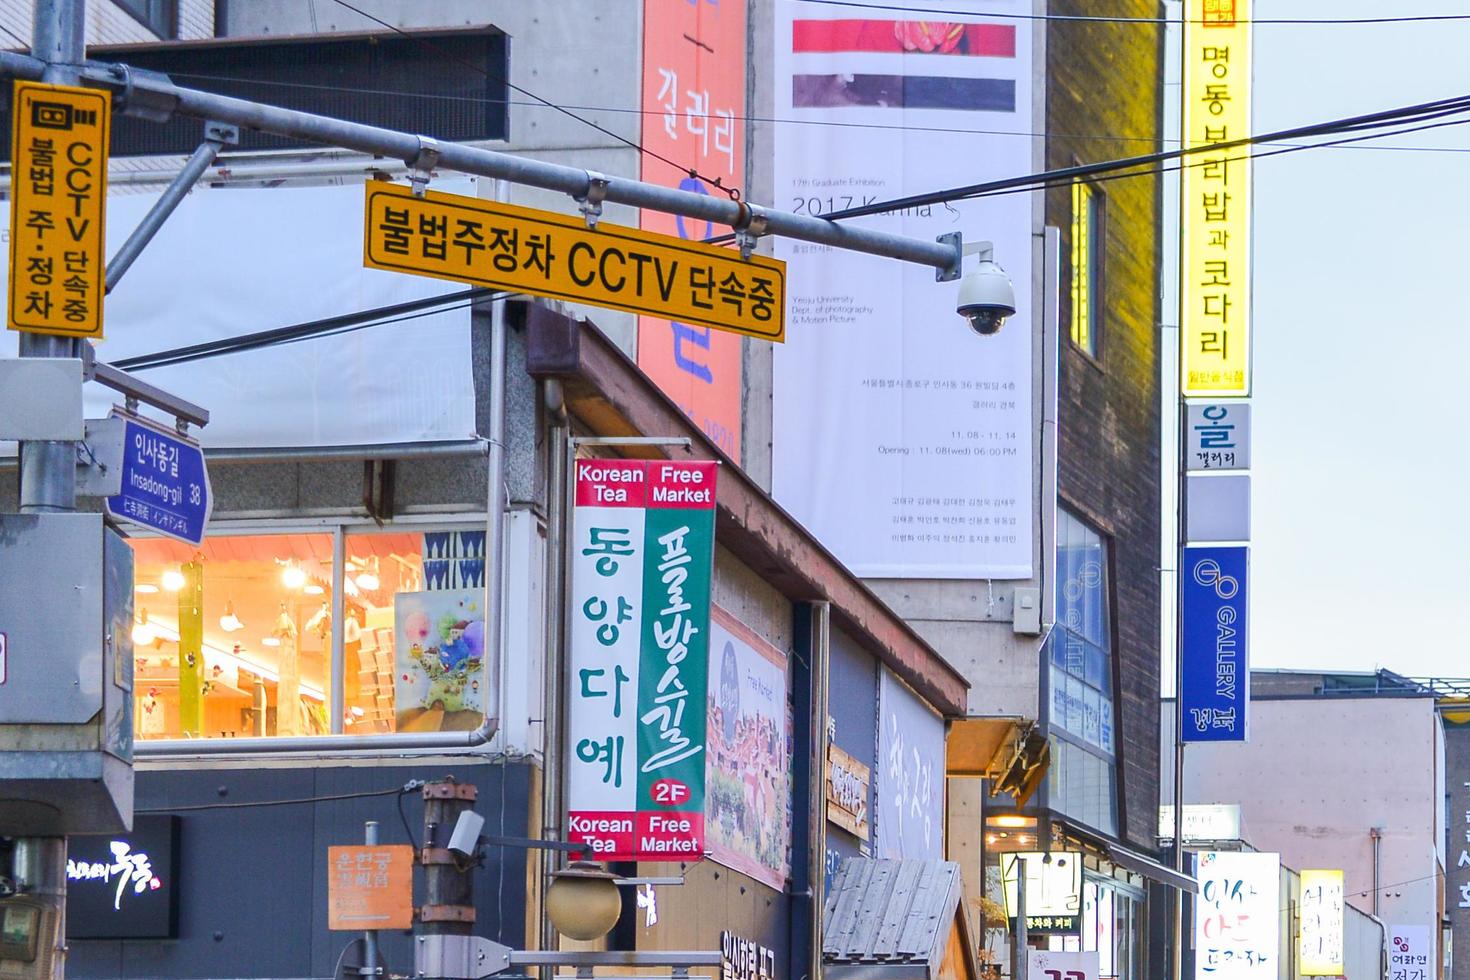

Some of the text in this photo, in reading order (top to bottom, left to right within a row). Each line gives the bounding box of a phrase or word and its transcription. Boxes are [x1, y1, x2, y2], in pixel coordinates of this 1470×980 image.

[28, 137, 57, 196] 불법
[849, 178, 886, 188] Exhibition
[792, 196, 854, 217] 2017
[62, 142, 93, 323] CCTV 단속중
[379, 205, 776, 323] 불법주정차 CCTV 단속중
[816, 295, 854, 305] University
[801, 316, 828, 324] Motion
[829, 315, 857, 324] Picture
[824, 306, 874, 315] photography
[134, 433, 180, 478] 인사동길
[878, 446, 910, 456] Opening
[1197, 451, 1235, 468] 갤러리
[578, 465, 704, 485] Korean Free
[130, 466, 201, 506] Insadong-gil 38
[593, 485, 710, 504] Tea Market
[575, 526, 635, 789] 동양다예
[640, 525, 703, 774] 프로방스길
[1217, 606, 1237, 699] GALLERY
[656, 783, 688, 802] 2F
[568, 815, 692, 834] Korean Free
[582, 835, 699, 853] Tea Market
[1055, 916, 1073, 930] 커피
